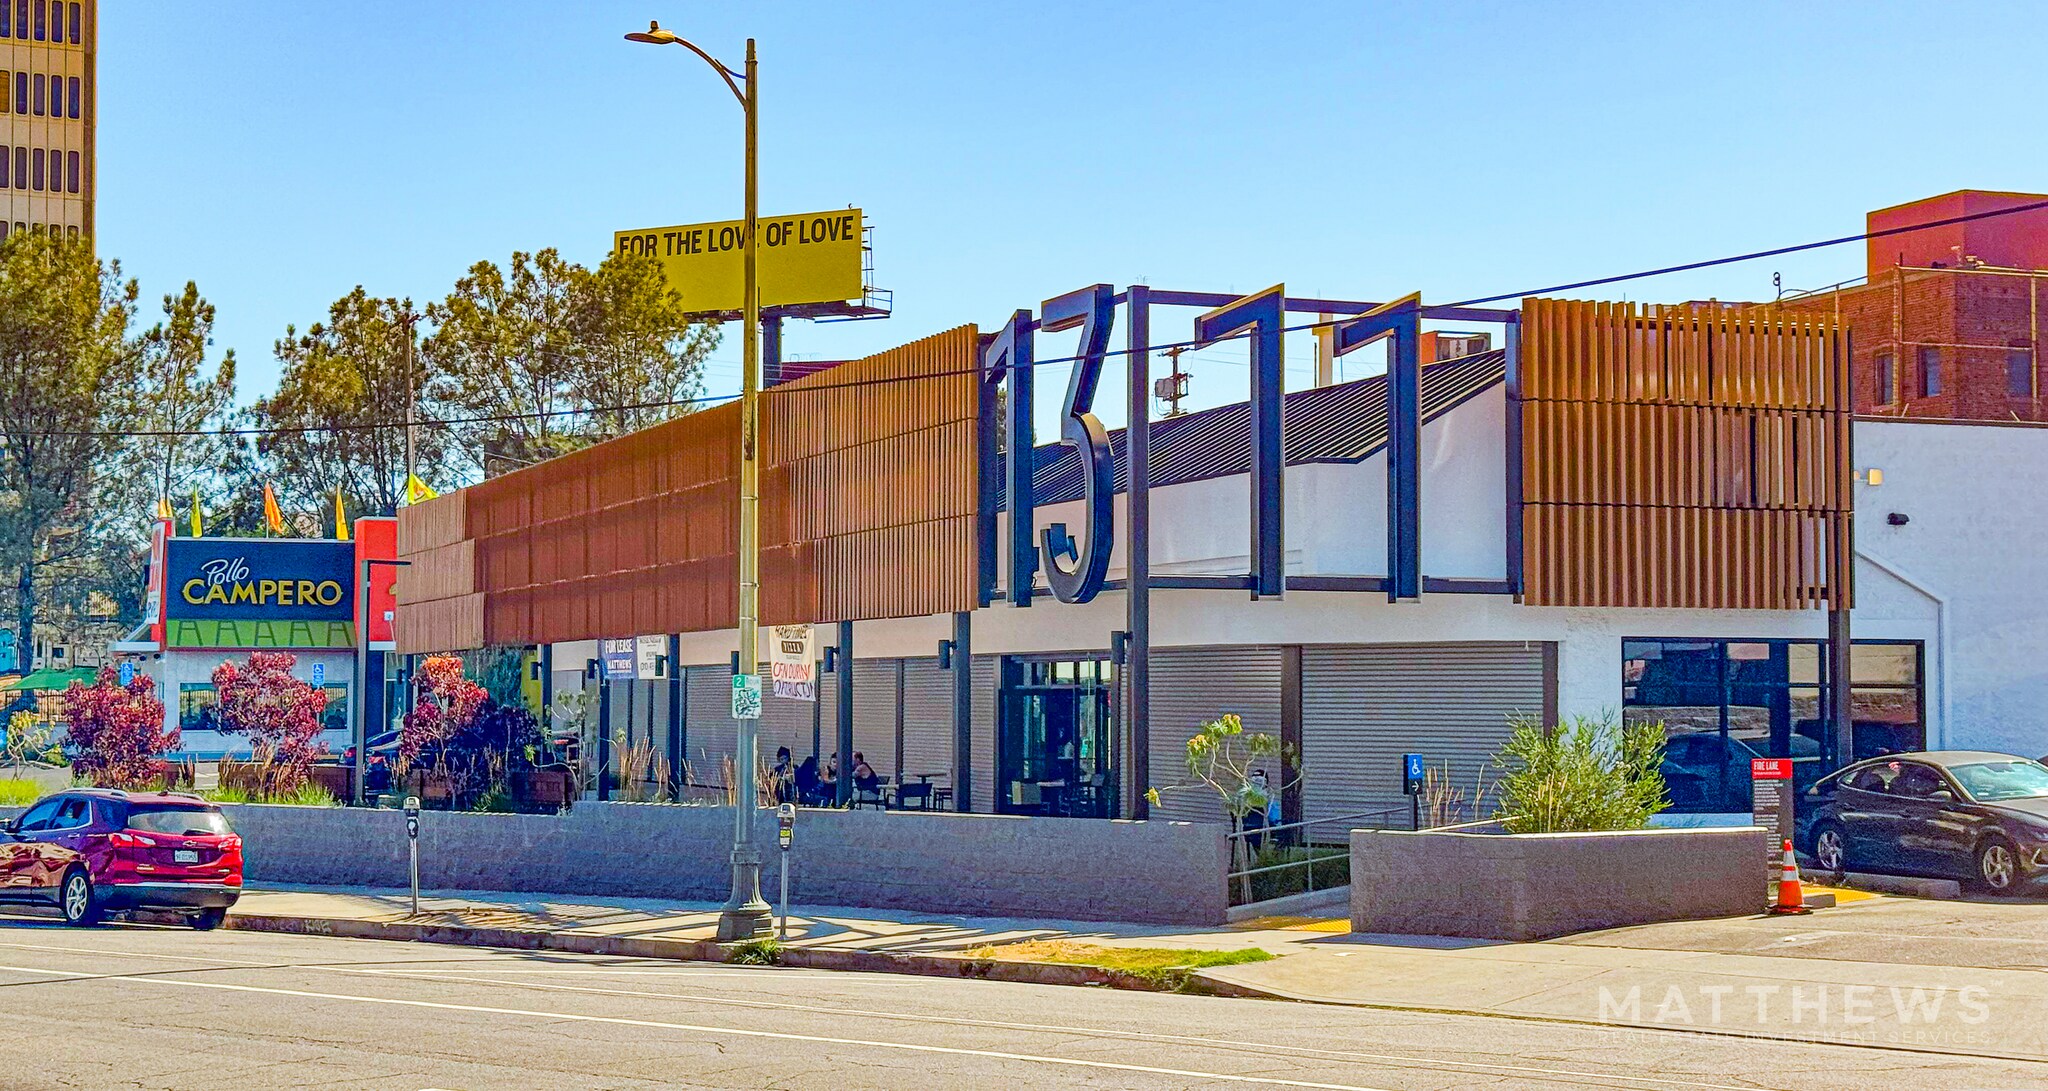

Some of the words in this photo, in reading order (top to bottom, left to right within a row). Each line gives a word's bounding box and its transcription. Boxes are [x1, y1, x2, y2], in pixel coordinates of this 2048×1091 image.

[619, 234, 657, 257] FOR
[663, 229, 702, 256] THE
[708, 223, 760, 252] LOV
[766, 221, 793, 247] OF
[799, 215, 854, 244] LOVE
[200, 556, 250, 587] Pollo
[182, 578, 343, 606] CAMPERO
[605, 640, 617, 654] FOR
[616, 639, 633, 653] LEASE
[607, 658, 632, 670] MATTHEWS
[736, 677, 742, 687] 2
[1754, 761, 1765, 770] FIRE
[1766, 761, 1779, 770] LANE
